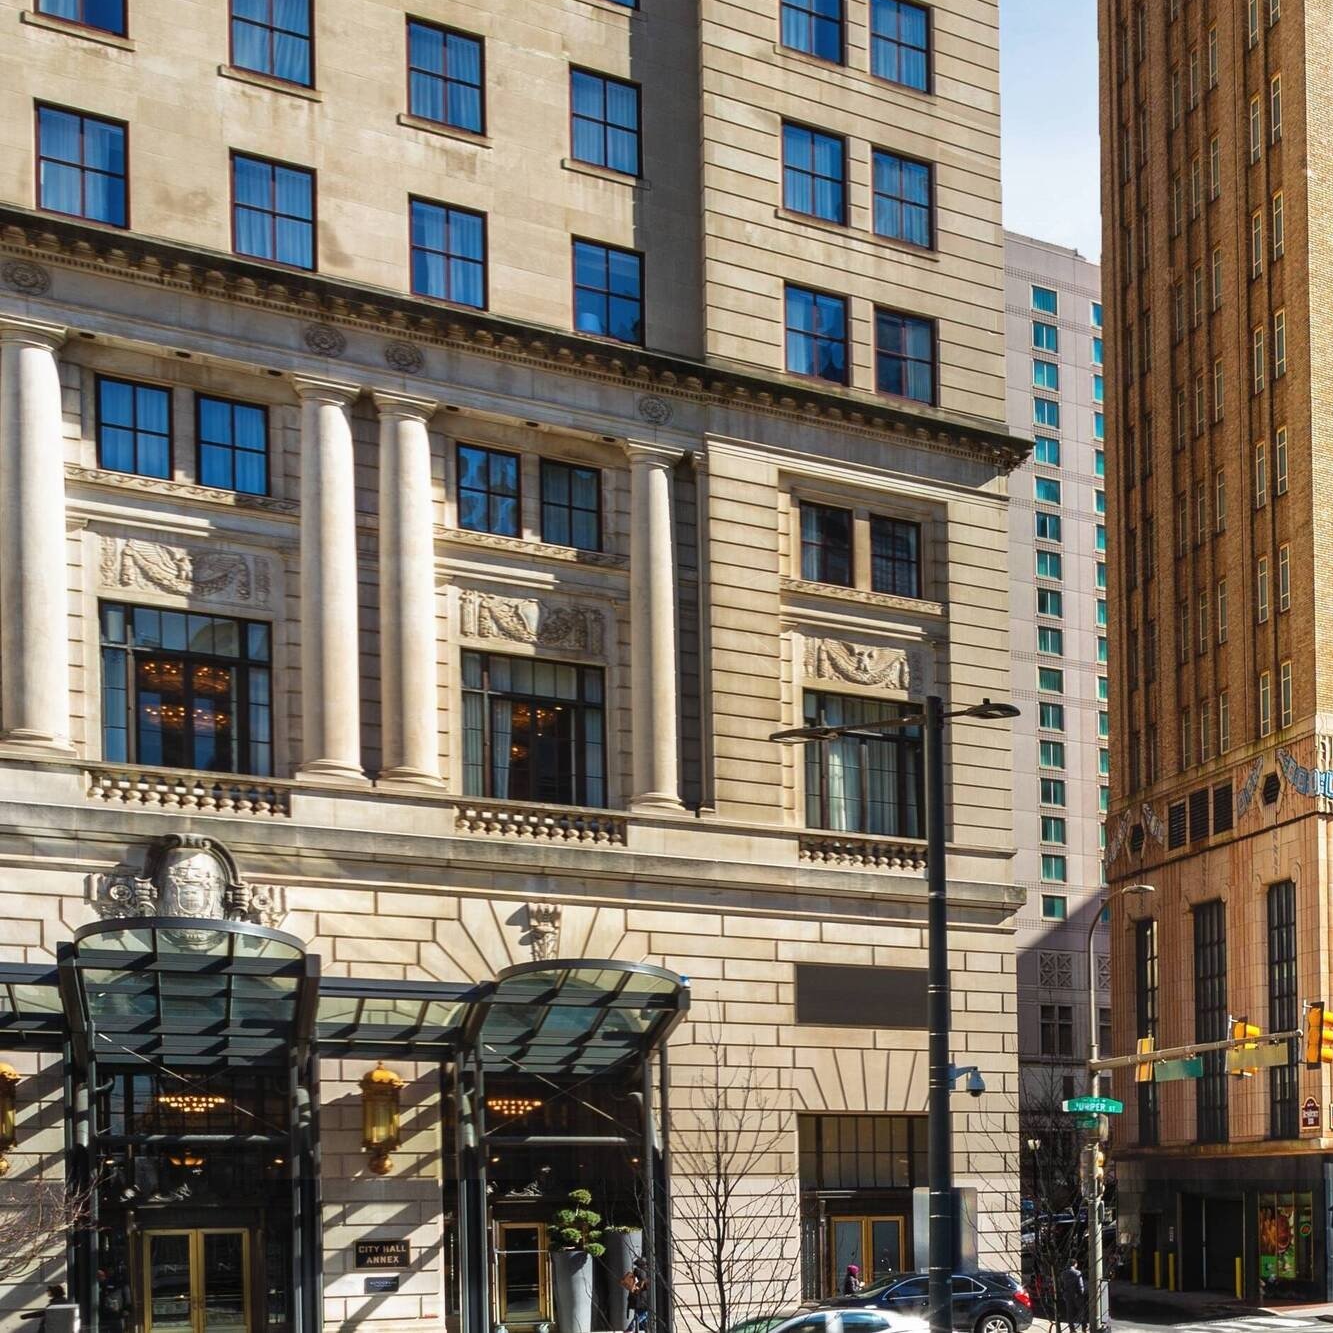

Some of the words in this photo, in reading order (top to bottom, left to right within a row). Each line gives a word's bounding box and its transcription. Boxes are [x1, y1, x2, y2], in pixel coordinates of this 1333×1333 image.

[358, 1245, 380, 1254] CITY
[383, 1244, 407, 1253] HALL
[366, 1255, 399, 1264] ANNEX
